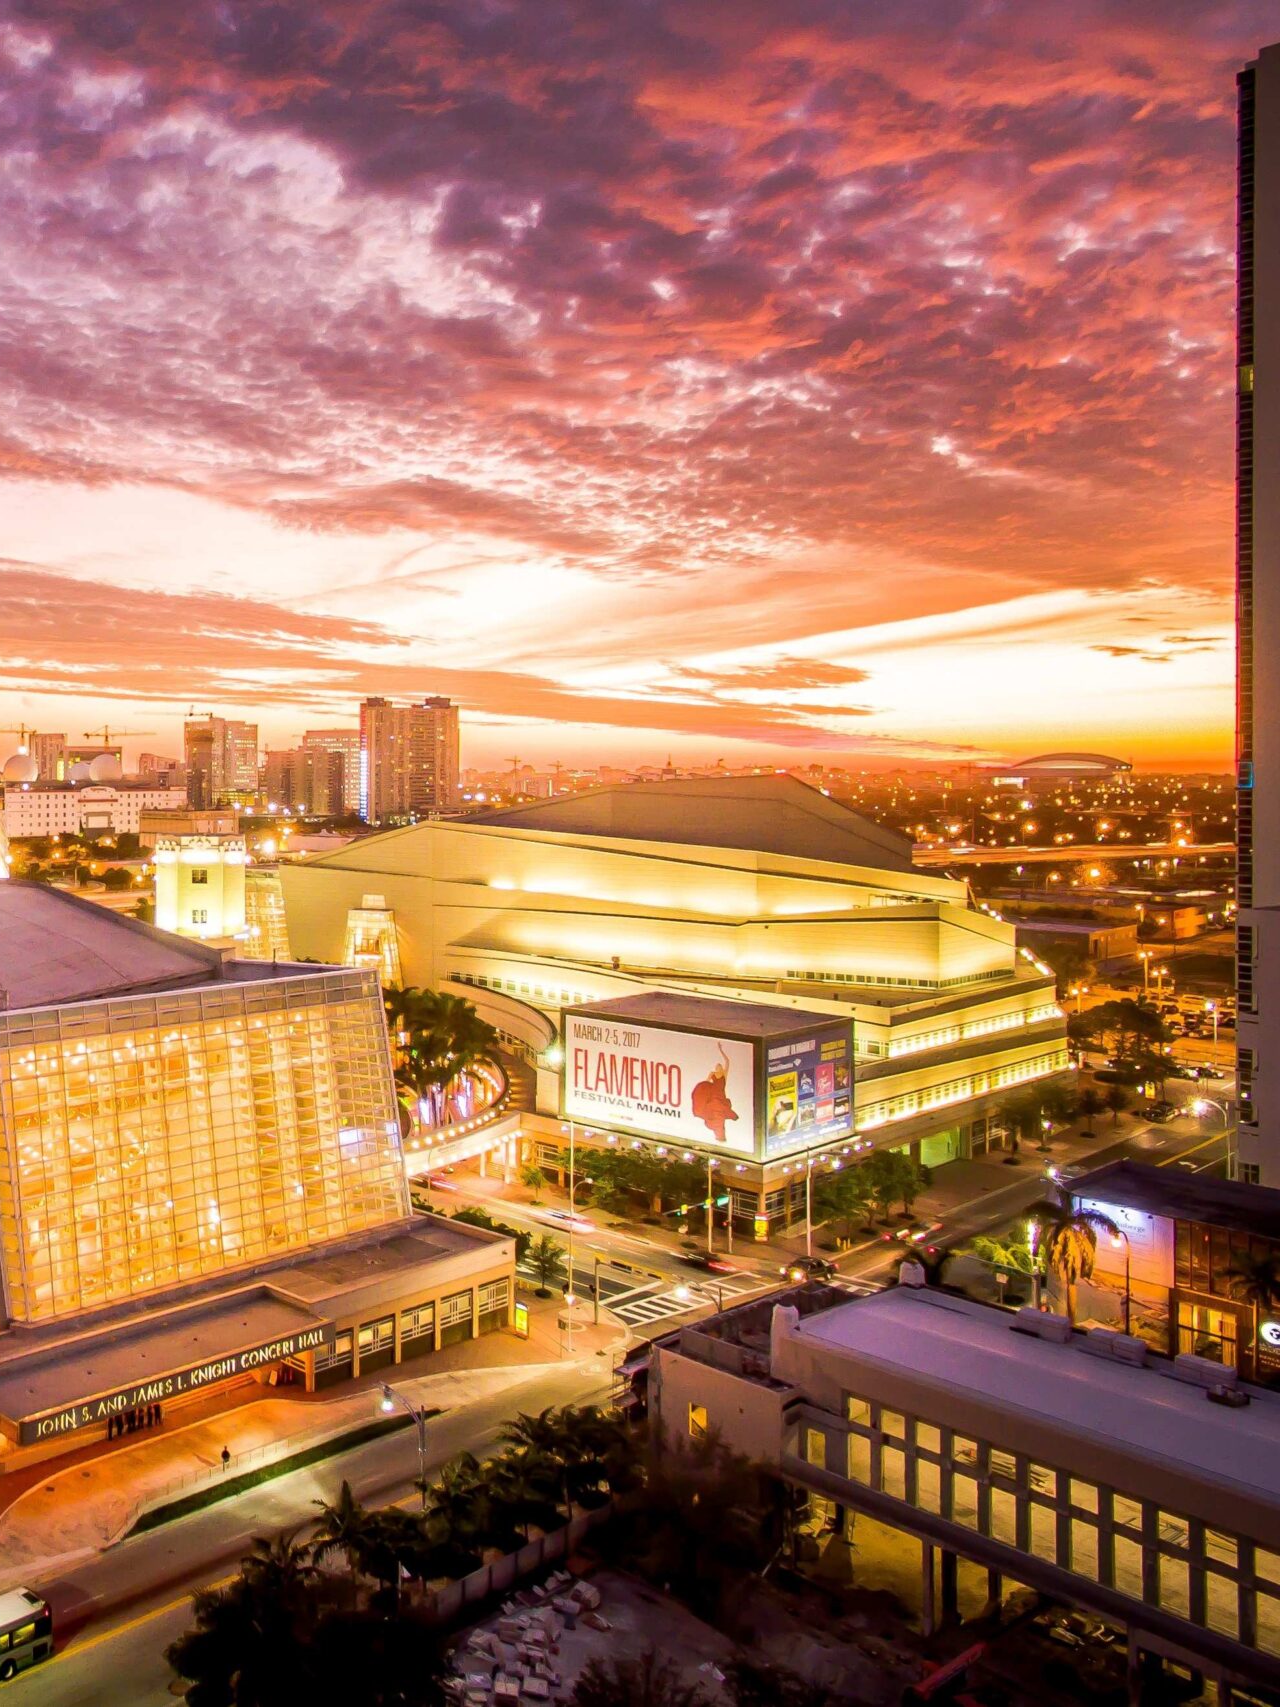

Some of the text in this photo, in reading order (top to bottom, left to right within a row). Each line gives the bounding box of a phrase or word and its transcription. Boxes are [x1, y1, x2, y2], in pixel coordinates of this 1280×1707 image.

[573, 1023, 641, 1048] MARCH 2-5, 2017
[574, 1047, 682, 1108] FLAMENCO
[574, 1090, 633, 1109] FESTIVAL
[636, 1103, 681, 1119] MIAMI
[36, 1328, 324, 1438] JOHN S. AND JAMES L. KNIGHT CONCERT HALL
